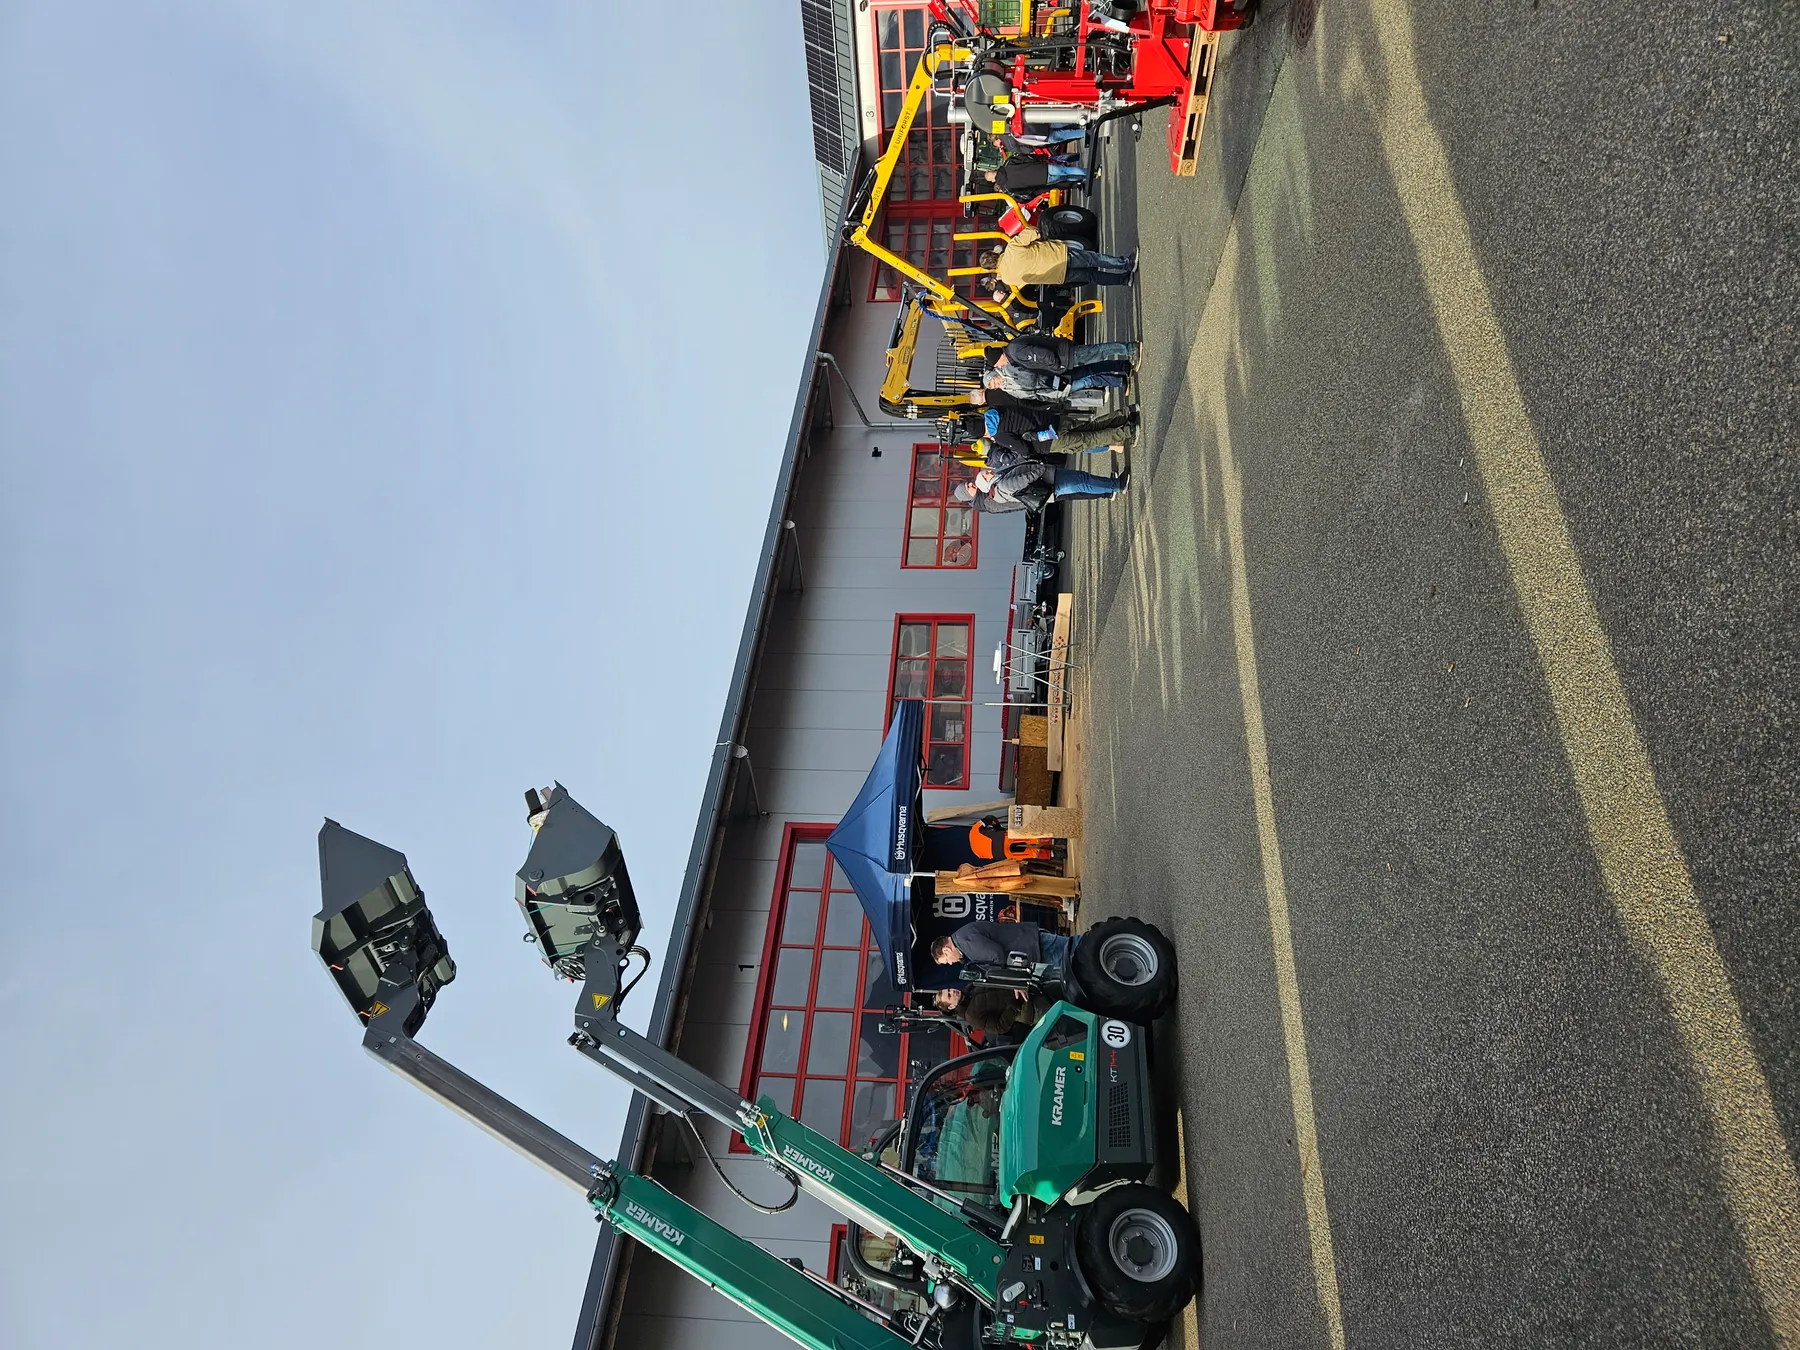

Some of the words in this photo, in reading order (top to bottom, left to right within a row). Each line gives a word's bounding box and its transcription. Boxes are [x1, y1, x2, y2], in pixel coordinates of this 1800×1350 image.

[866, 110, 874, 118] 3
[894, 112, 911, 144] UNIFORST
[896, 805, 906, 850] Husqvarna
[738, 964, 754, 972] 1
[1106, 1026, 1125, 1042] 30
[1052, 1066, 1066, 1126] KRAMER
[782, 1144, 835, 1182] KRAMER
[625, 1201, 686, 1246] KRAMER
